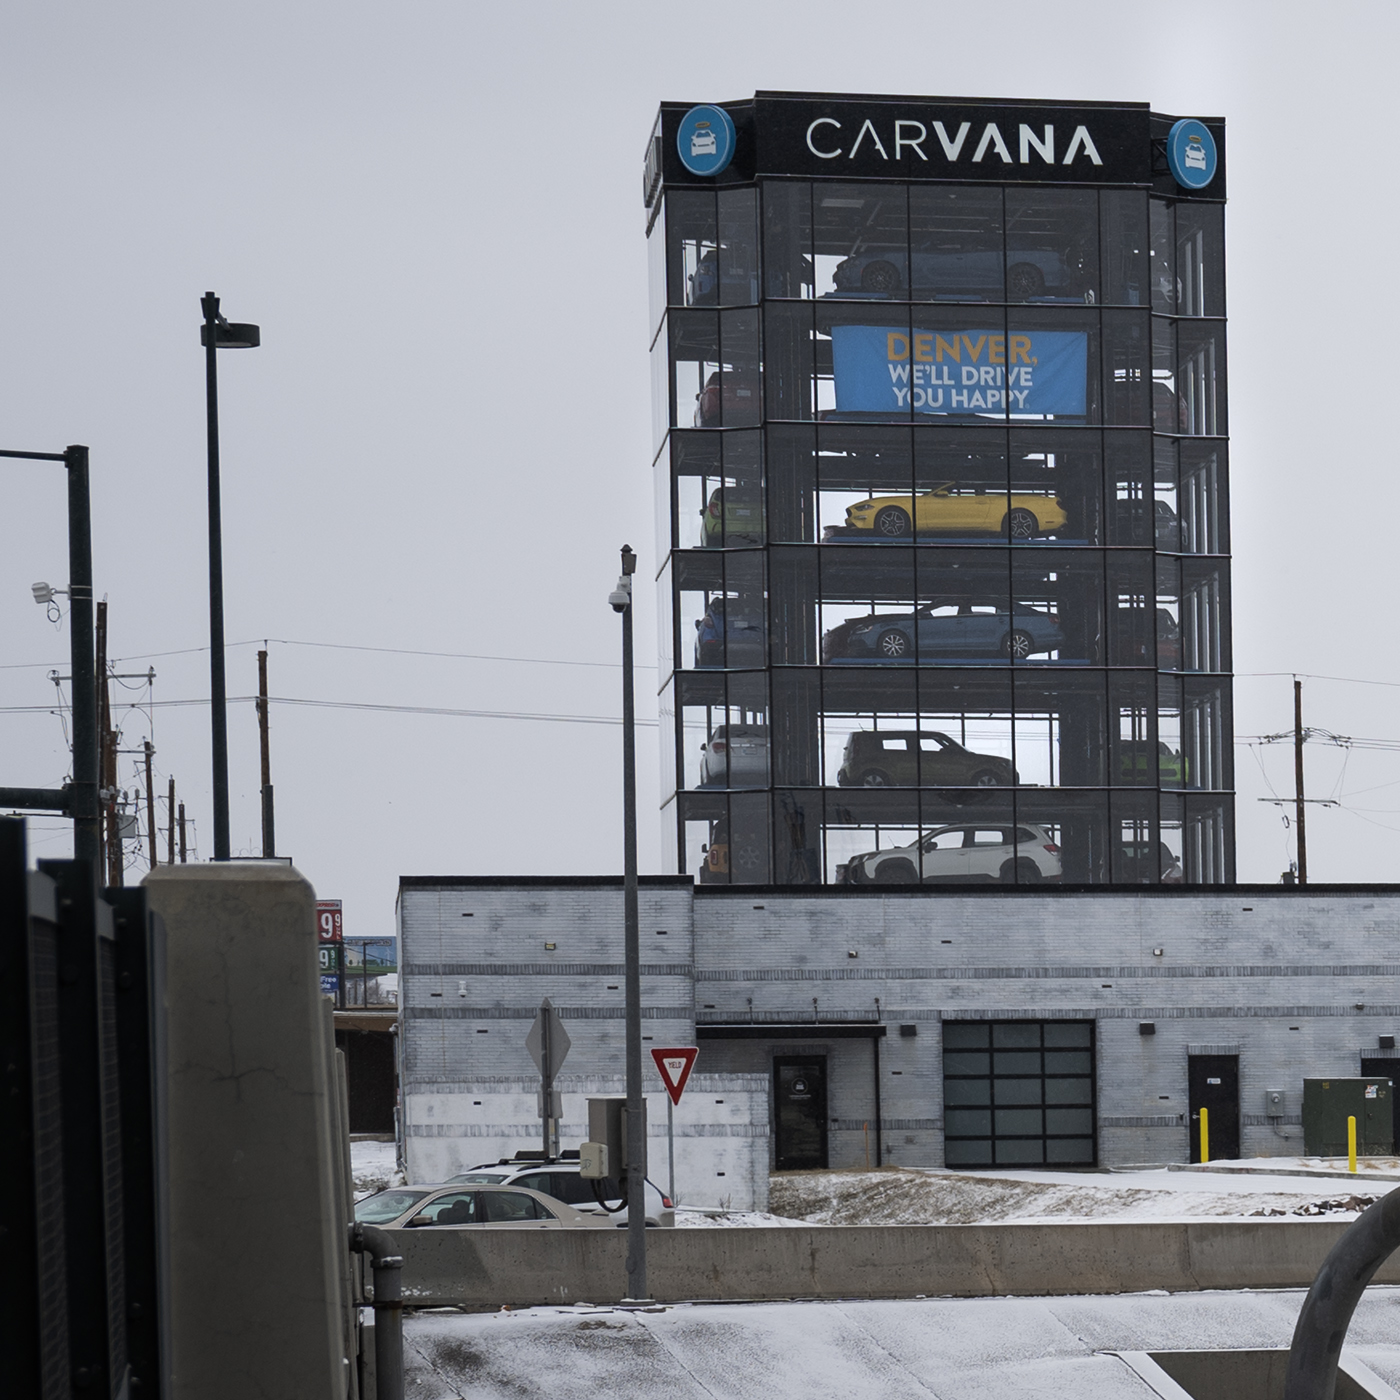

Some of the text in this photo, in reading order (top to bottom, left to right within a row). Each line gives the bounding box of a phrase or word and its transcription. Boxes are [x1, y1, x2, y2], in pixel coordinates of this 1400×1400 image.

[806, 117, 1103, 165] CARVANA
[886, 332, 1038, 367] DENVER,
[888, 364, 1033, 387] WE'LL DRIVE
[892, 386, 944, 408] YOU
[668, 1061, 682, 1069] YIELD
